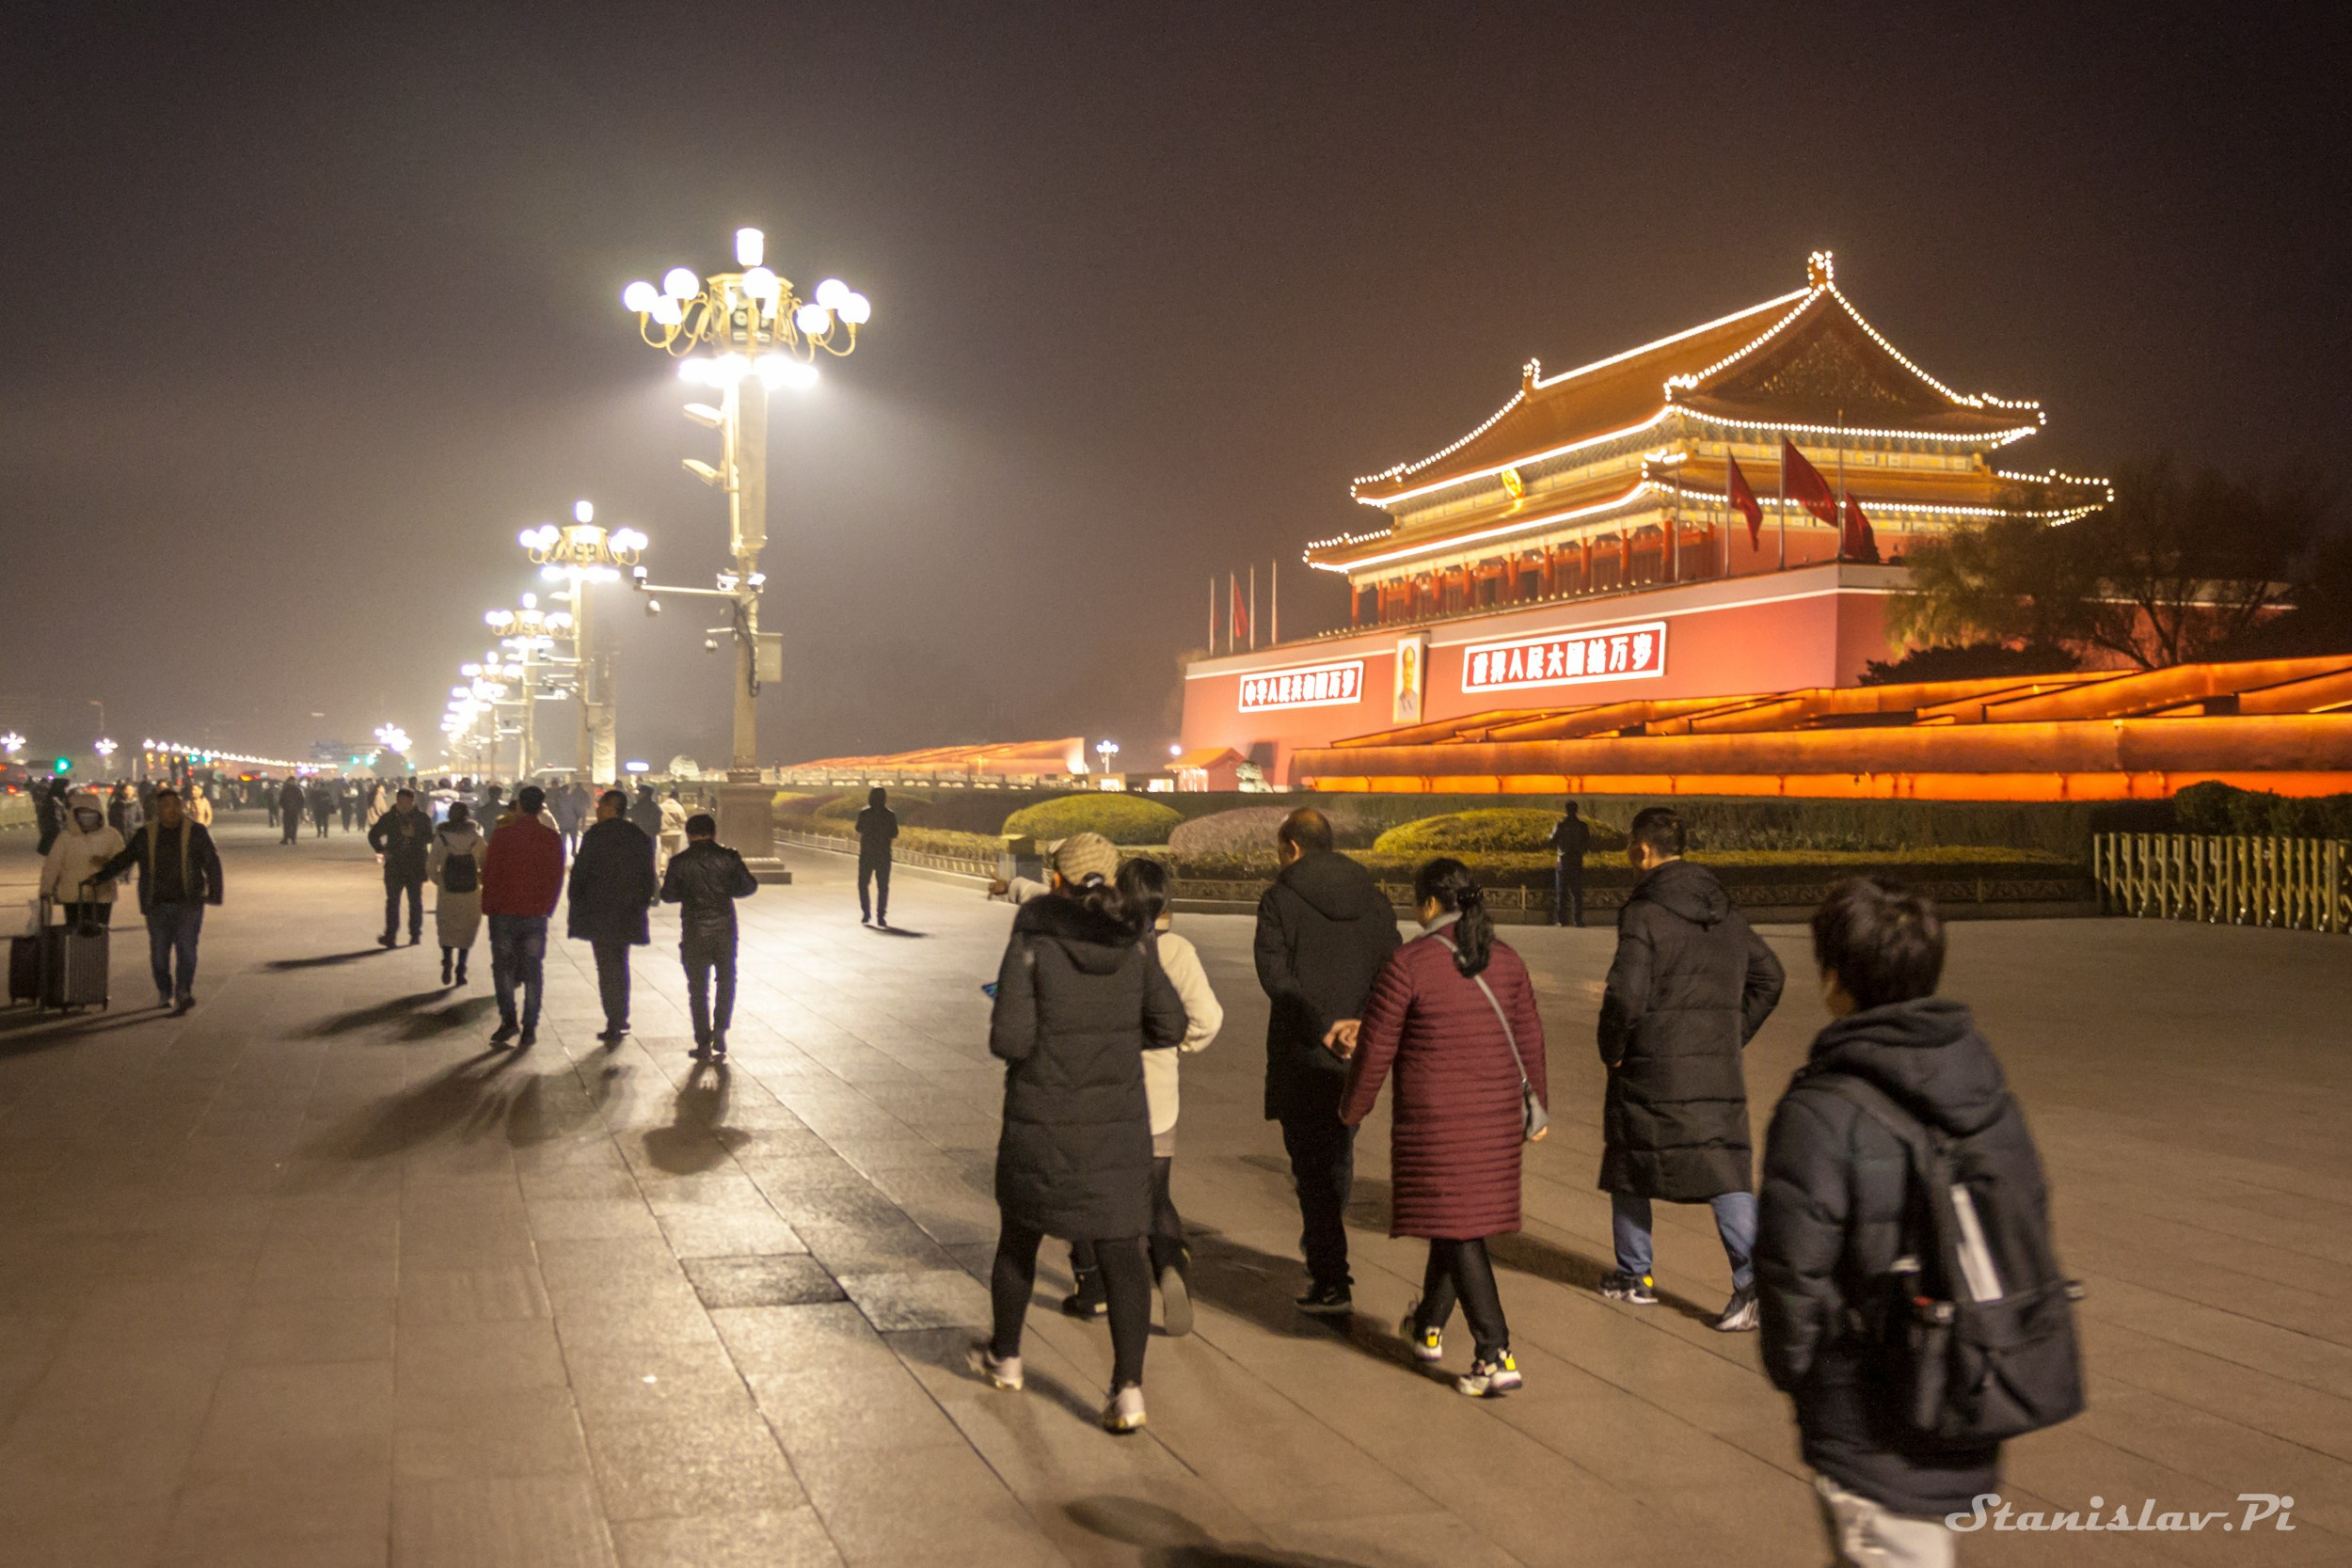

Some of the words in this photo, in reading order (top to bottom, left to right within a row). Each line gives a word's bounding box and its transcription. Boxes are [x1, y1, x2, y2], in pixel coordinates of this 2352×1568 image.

[1472, 633, 1653, 685] 世界人民大团结万岁
